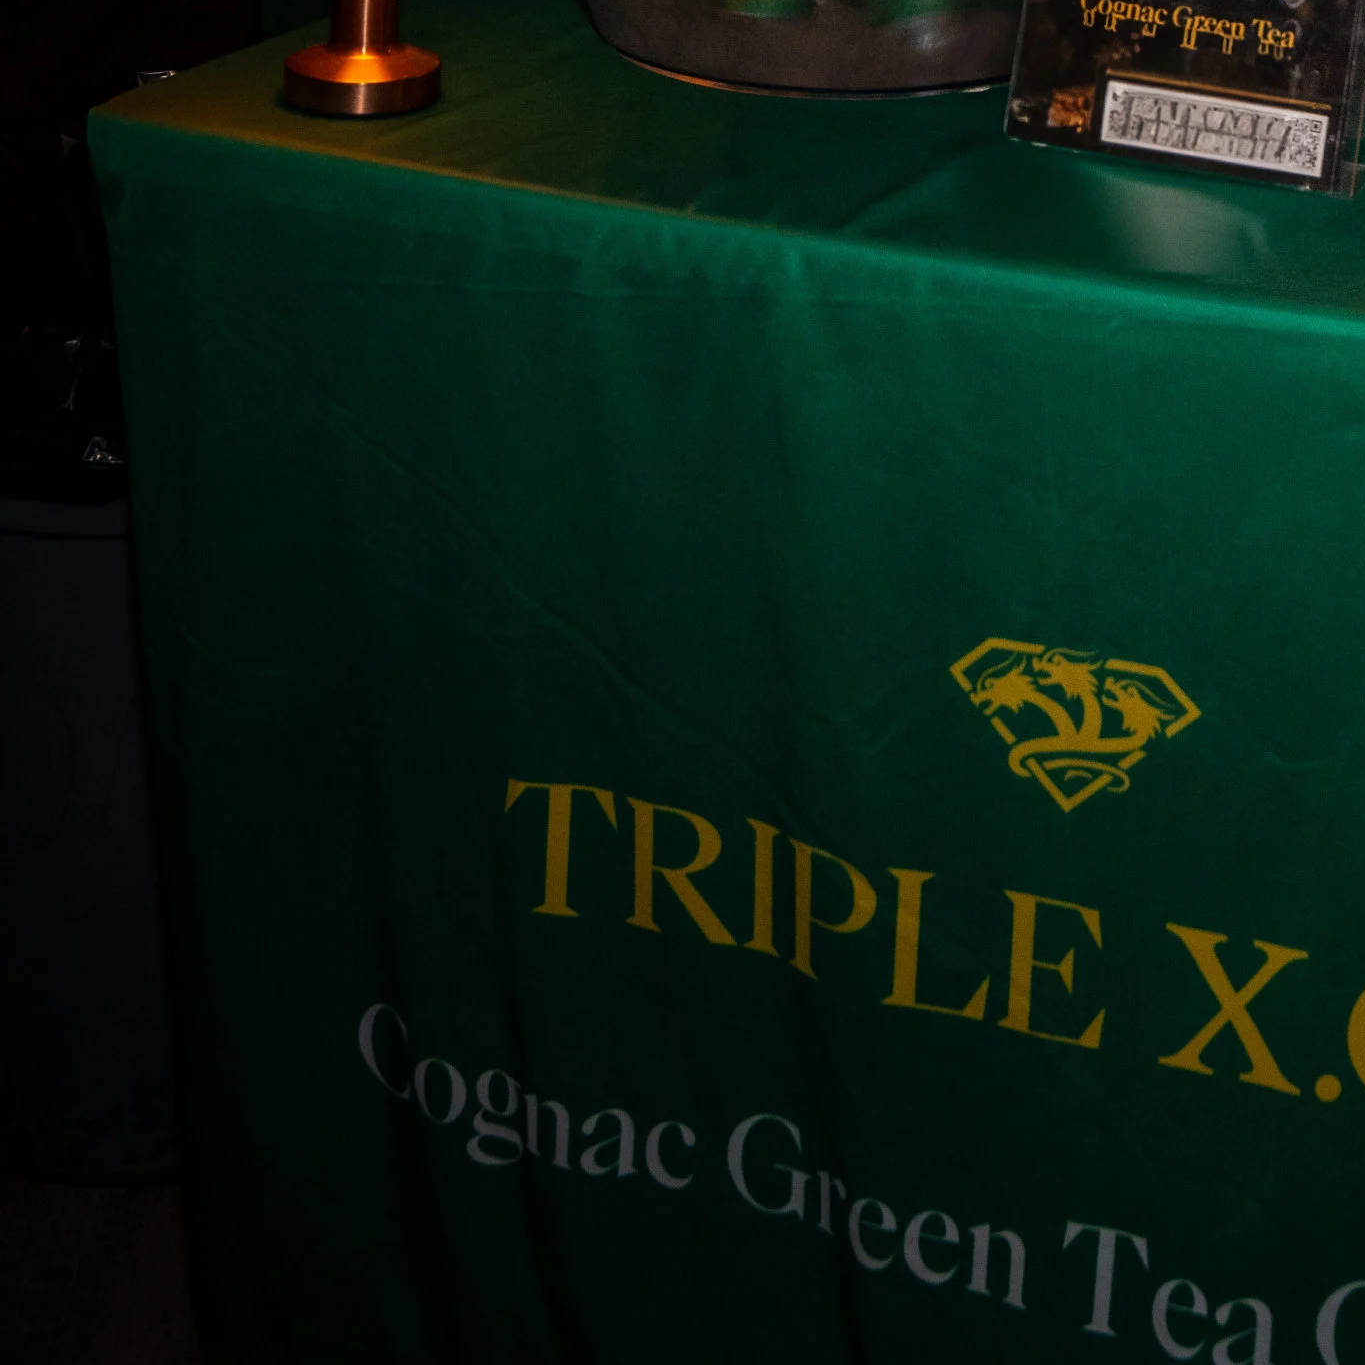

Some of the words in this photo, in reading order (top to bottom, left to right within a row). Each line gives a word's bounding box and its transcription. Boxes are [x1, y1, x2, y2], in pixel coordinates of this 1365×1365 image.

[1173, 5, 1246, 48] Green
[1252, 18, 1296, 51] Tea
[503, 776, 1107, 1050] TRIPLE
[357, 1002, 697, 1190] Cognac
[726, 1112, 1027, 1309] Green
[1061, 1220, 1276, 1365] Tea
